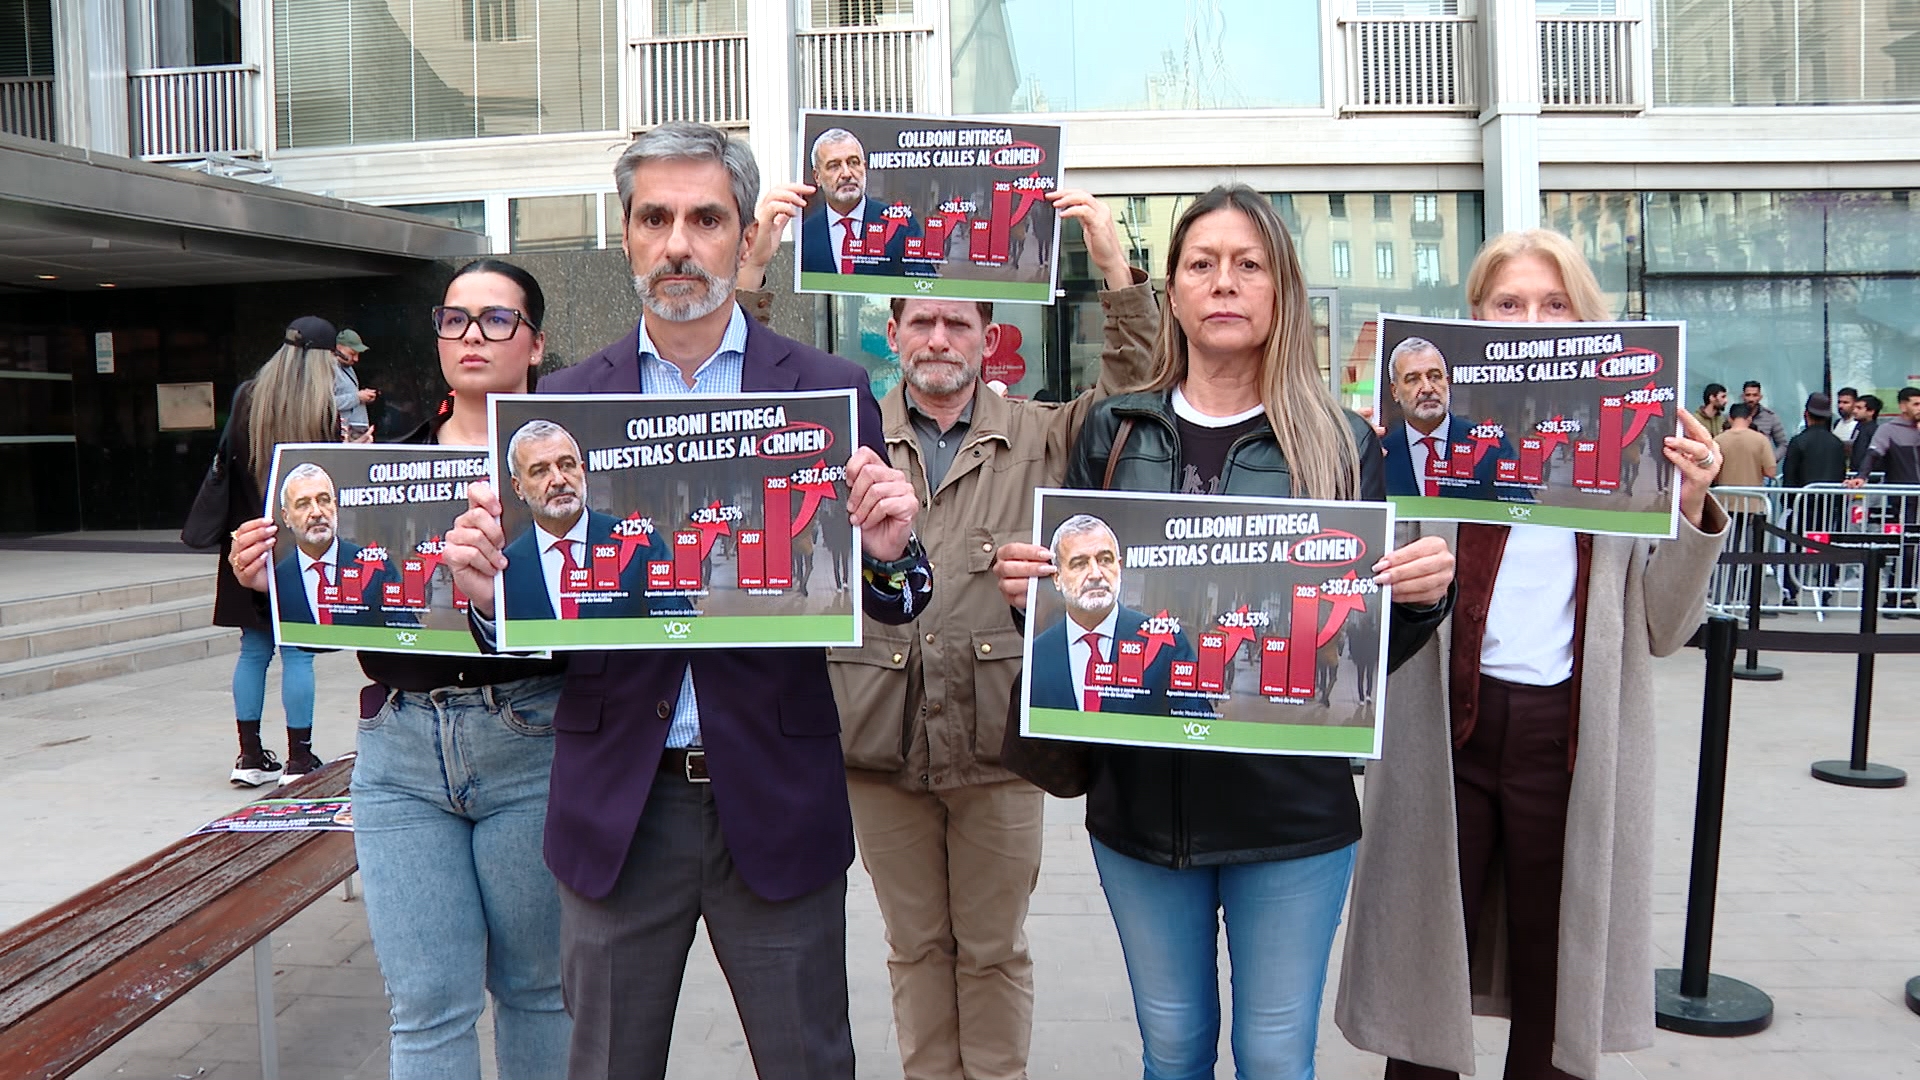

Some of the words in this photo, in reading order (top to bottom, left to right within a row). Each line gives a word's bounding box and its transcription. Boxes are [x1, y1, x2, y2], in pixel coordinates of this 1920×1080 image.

[899, 131, 956, 148] COLLBONI
[958, 129, 1012, 146] ENTREGA
[870, 151, 930, 169] NUESTRAS
[933, 150, 974, 166] CALLES
[977, 150, 992, 166] AL
[995, 148, 1039, 165] CRIMEN
[996, 183, 1009, 191] 2025
[1013, 177, 1054, 190] +387,66%
[940, 201, 976, 213] +291,53%
[913, 279, 933, 290] VOX
[1486, 340, 1554, 360] COLLBONI
[1557, 334, 1623, 356] ENTREGA
[1453, 365, 1524, 383] NUESTRAS
[1527, 361, 1577, 381] CALLES
[1580, 360, 1598, 378] AL
[1601, 354, 1655, 376] CRIMEN
[627, 413, 708, 440] COLLBONI
[711, 406, 786, 433] ENTREGA
[589, 444, 674, 471] NUESTRAS
[678, 438, 735, 462] CALLES
[739, 436, 759, 456] AL
[764, 429, 825, 454] CRIMEN
[370, 462, 431, 482] COLLBONI
[434, 458, 489, 477] ENTREGA
[790, 466, 846, 485] +387,66%
[768, 479, 786, 488] 2025
[340, 486, 405, 506] NUESTRAS
[407, 483, 452, 502] CALLES
[691, 506, 742, 523] +291,53%
[1508, 506, 1531, 517] VOX
[614, 519, 653, 536] +125%
[1166, 516, 1243, 540] COLLBONI
[1246, 513, 1319, 535] ENTREGA
[678, 534, 697, 544] 2025
[742, 534, 759, 543] 2017
[416, 541, 446, 555] +291,5
[596, 547, 615, 557] 2025
[1126, 544, 1208, 568] NUESTRAS
[1211, 542, 1268, 564] CALLES
[1270, 541, 1291, 562] AL
[1293, 537, 1357, 561] CRIMEN
[570, 570, 588, 580] 2017
[652, 565, 669, 574] 2017
[1296, 586, 1316, 598] 2025
[1320, 578, 1378, 595] +387,66%
[1141, 617, 1180, 634] +125%
[1218, 612, 1269, 627] +291,53%
[664, 620, 691, 634] VOX
[1122, 643, 1140, 654] 2025
[1203, 637, 1222, 647] 2025
[1267, 640, 1285, 651] 2017
[1095, 664, 1112, 675] 2017
[1175, 665, 1192, 675] 2017
[1183, 721, 1211, 736] VOX
